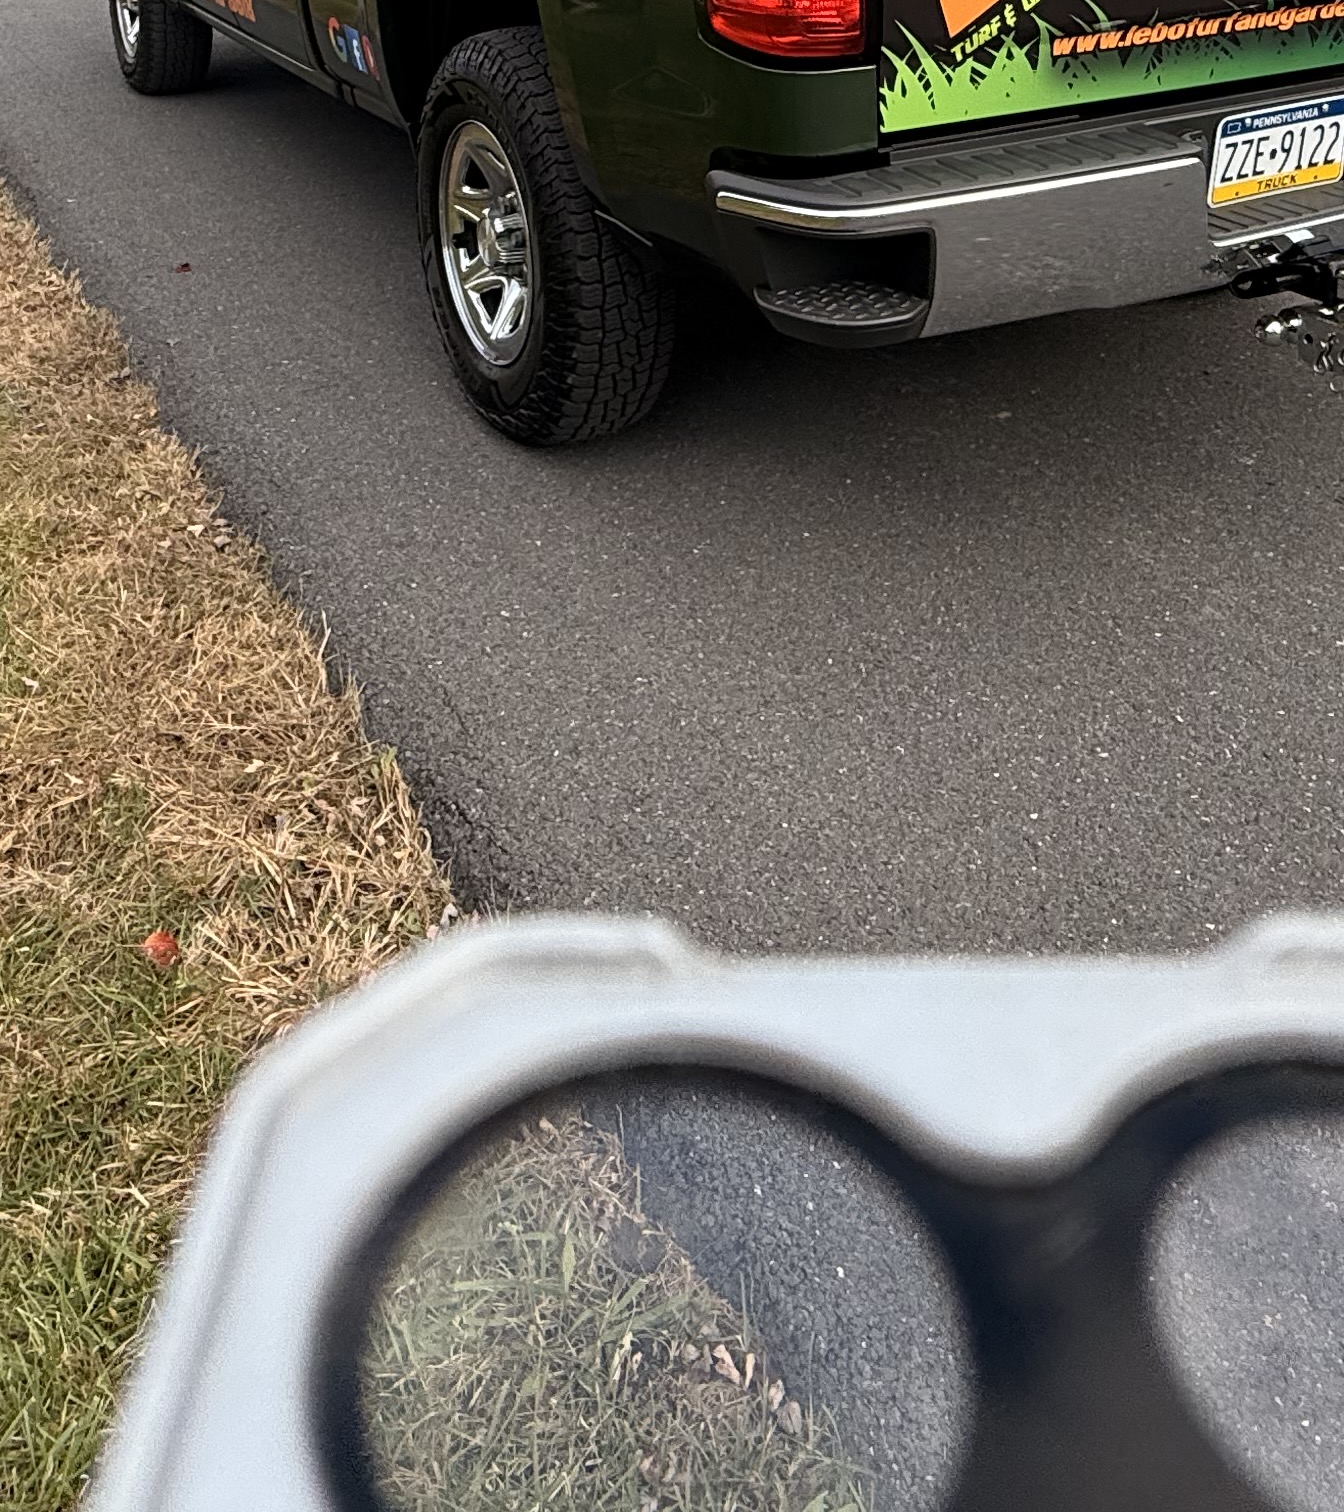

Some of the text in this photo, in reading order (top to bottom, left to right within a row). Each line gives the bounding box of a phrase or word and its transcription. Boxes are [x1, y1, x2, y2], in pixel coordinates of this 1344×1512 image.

[950, 14, 1001, 63] TURF
[1003, 2, 1017, 28] &
[1253, 106, 1319, 129] PENNSYLVANIA
[1256, 173, 1299, 193] TRUCK
